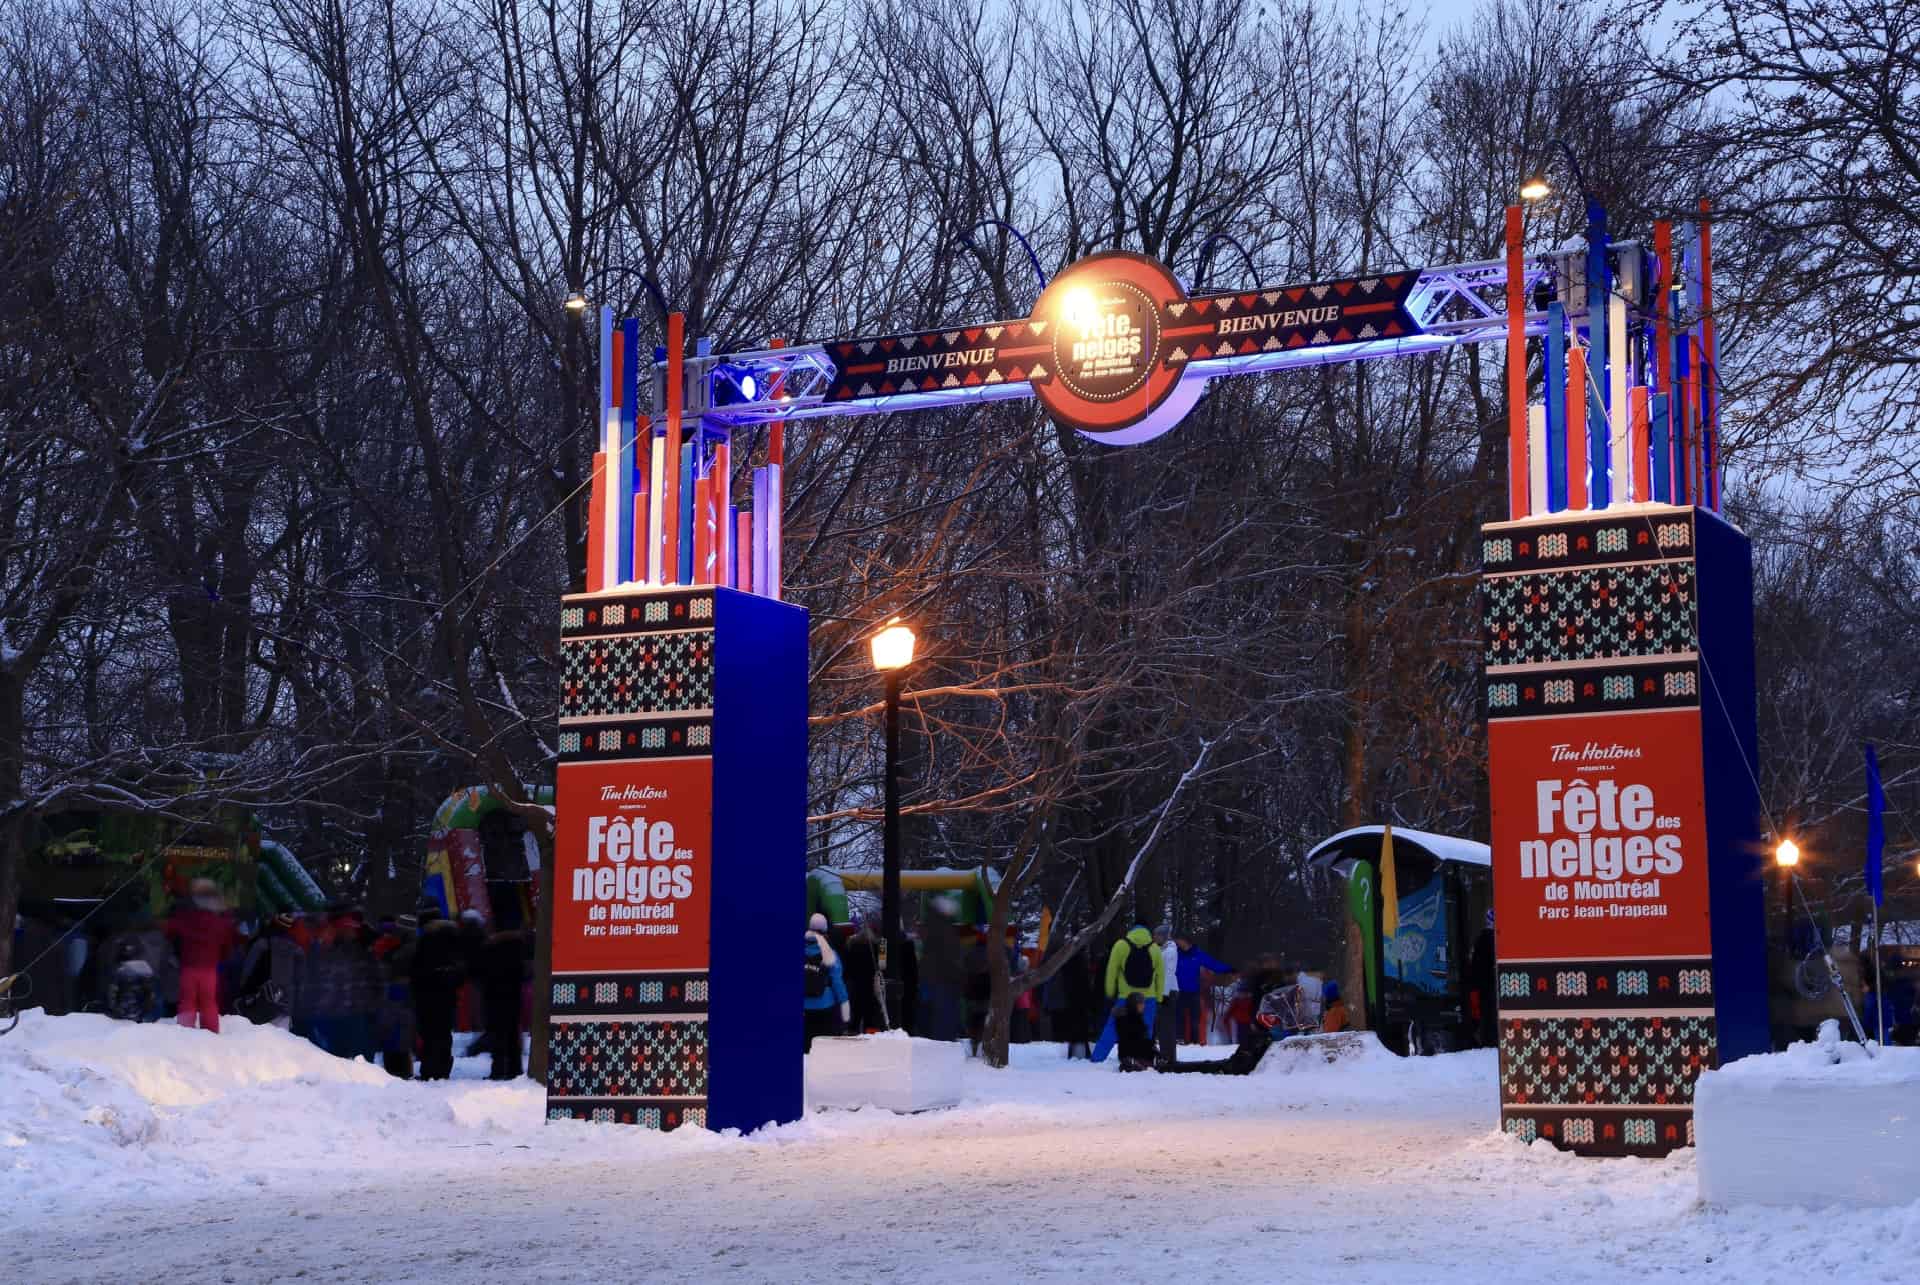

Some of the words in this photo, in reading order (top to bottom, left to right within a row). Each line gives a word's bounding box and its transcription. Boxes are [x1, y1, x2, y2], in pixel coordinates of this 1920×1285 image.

[1218, 305, 1339, 335] BIENVENUE
[887, 347, 995, 374] BIENVENUE
[1073, 336, 1141, 362] neiges
[1551, 744, 1580, 762] Tim
[1581, 742, 1642, 760] Hortons
[600, 786, 622, 801] Tim
[622, 784, 668, 800] Hortons
[1536, 778, 1654, 834] Fête
[1656, 816, 1681, 829] des
[587, 816, 674, 863] Fête
[674, 848, 693, 860] des
[1520, 832, 1684, 881] neiges
[572, 863, 693, 904] neiges
[1545, 882, 1569, 901] de
[1574, 879, 1660, 900] Montréal
[589, 905, 606, 920] de
[610, 903, 674, 920] Montréal
[1538, 905, 1570, 920] Parc
[1574, 903, 1668, 918] Jean-Drapeau
[584, 924, 606, 937] Parc
[609, 924, 679, 936] Jean-Drapeau
